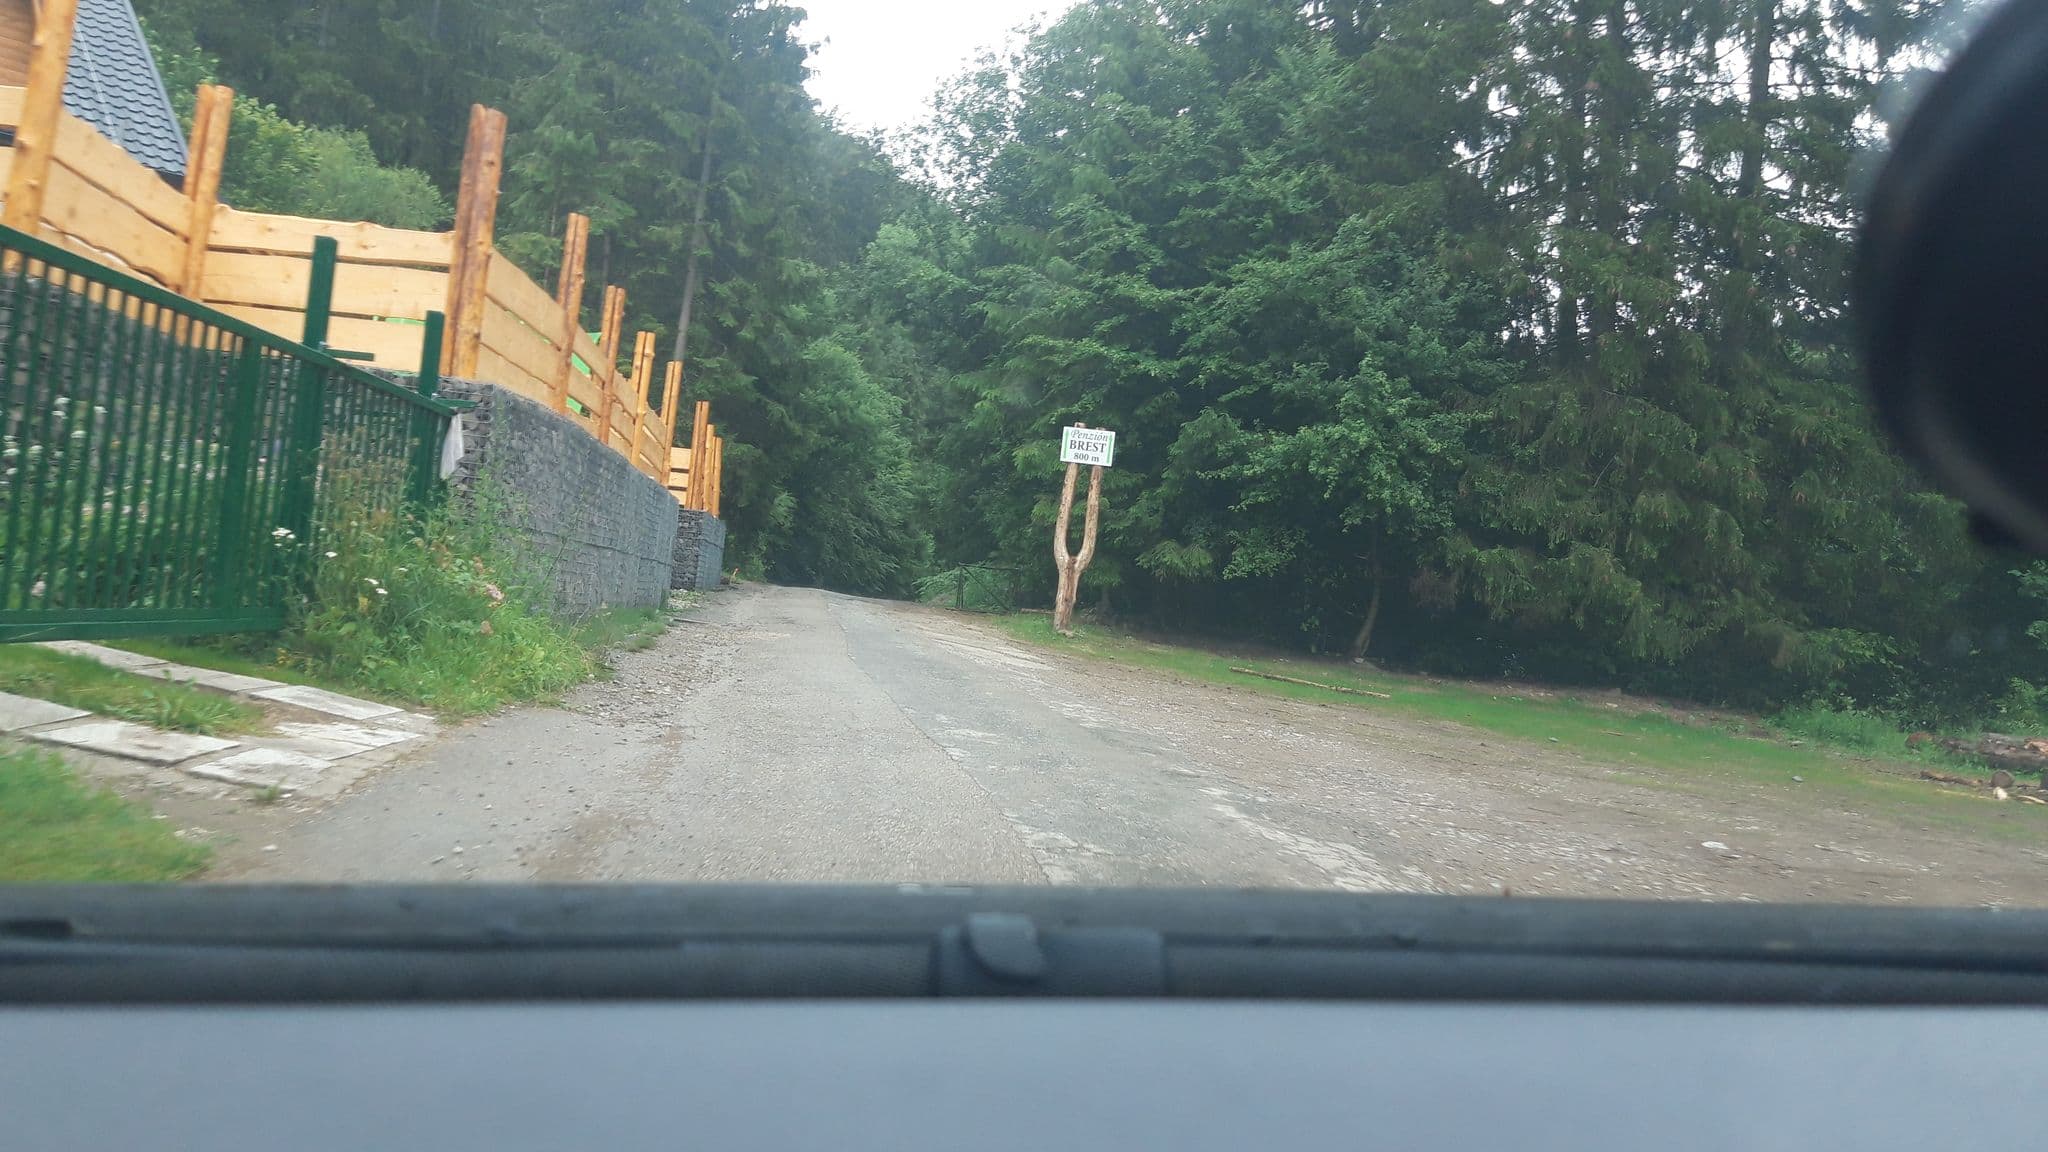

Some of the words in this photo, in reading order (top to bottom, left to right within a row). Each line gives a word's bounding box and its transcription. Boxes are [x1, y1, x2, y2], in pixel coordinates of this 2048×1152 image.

[1071, 429, 1108, 442] Penzión
[1069, 440, 1106, 453] BREST
[1073, 452, 1089, 461] 800
